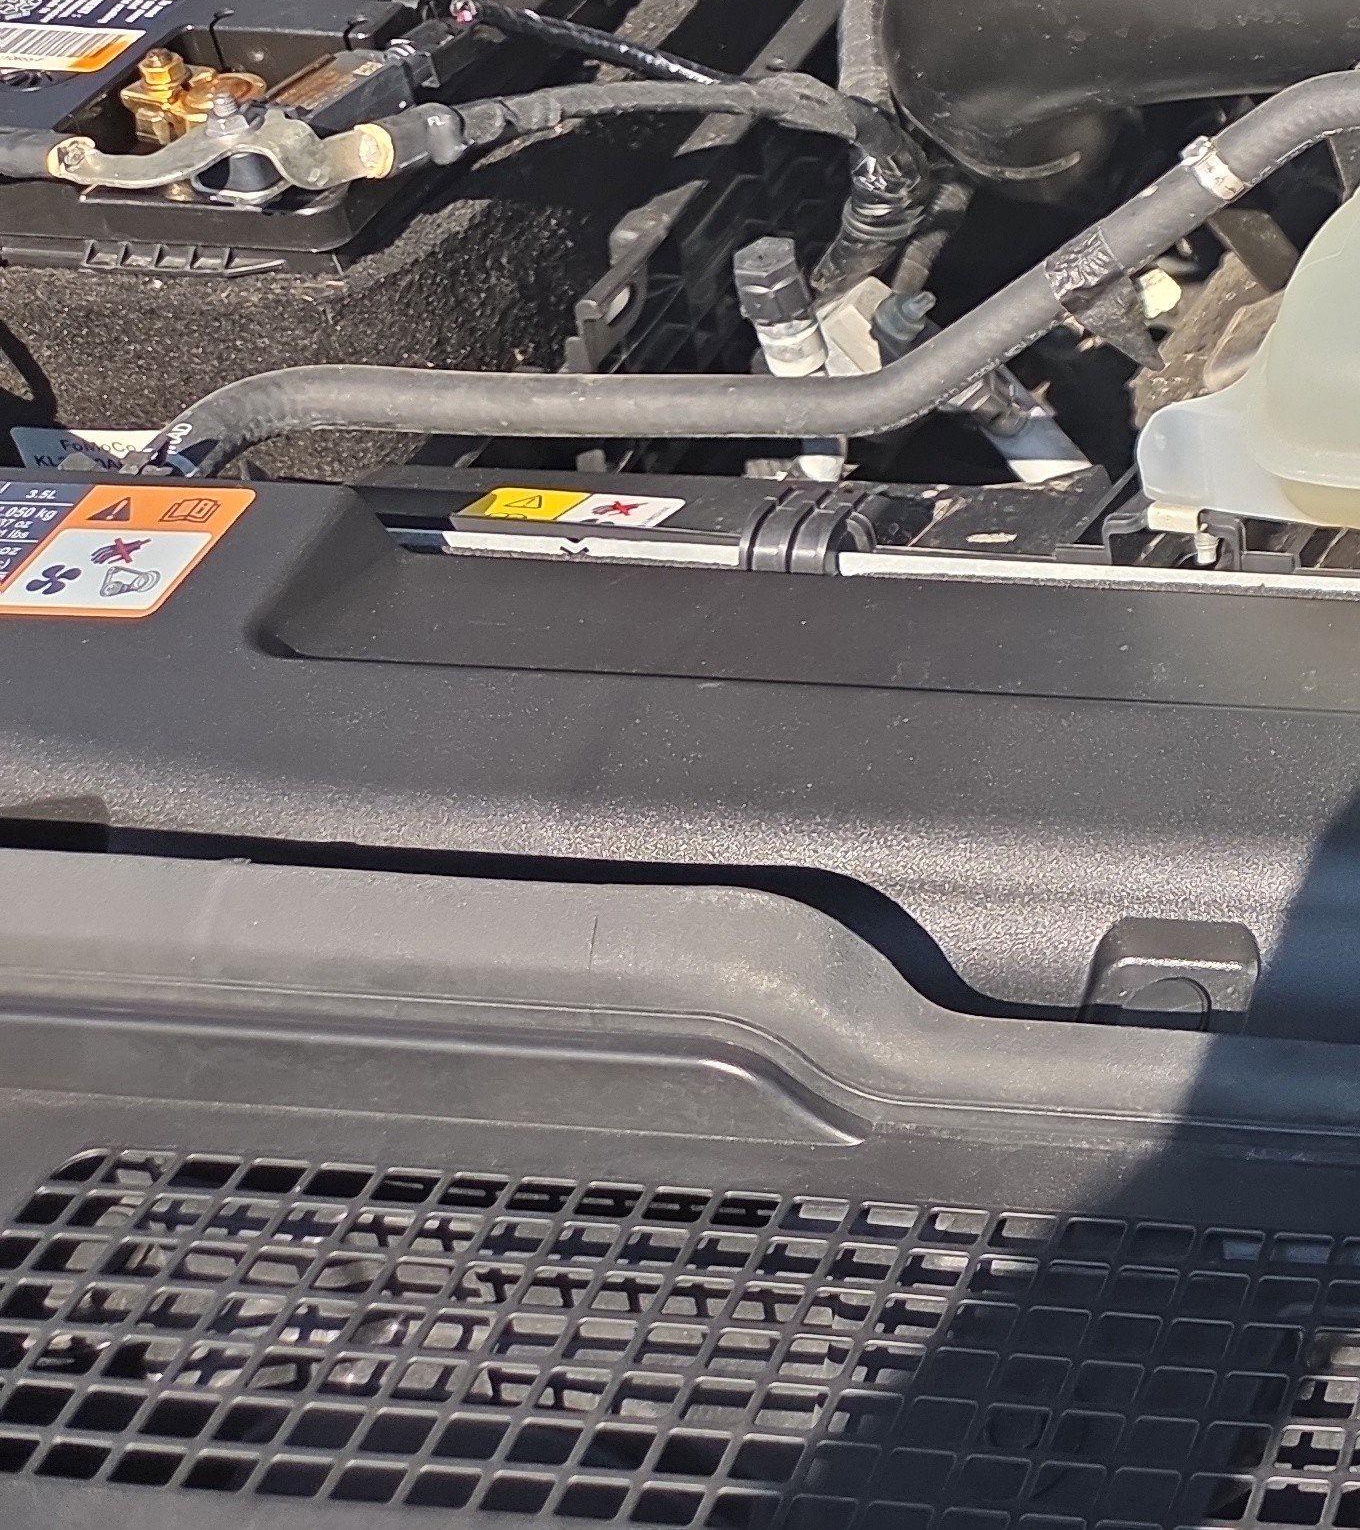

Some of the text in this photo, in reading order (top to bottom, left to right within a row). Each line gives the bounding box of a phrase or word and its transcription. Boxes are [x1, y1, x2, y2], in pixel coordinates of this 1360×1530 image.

[25, 489, 57, 500] 3.5L
[34, 507, 58, 522] kg
[14, 520, 33, 529] oz
